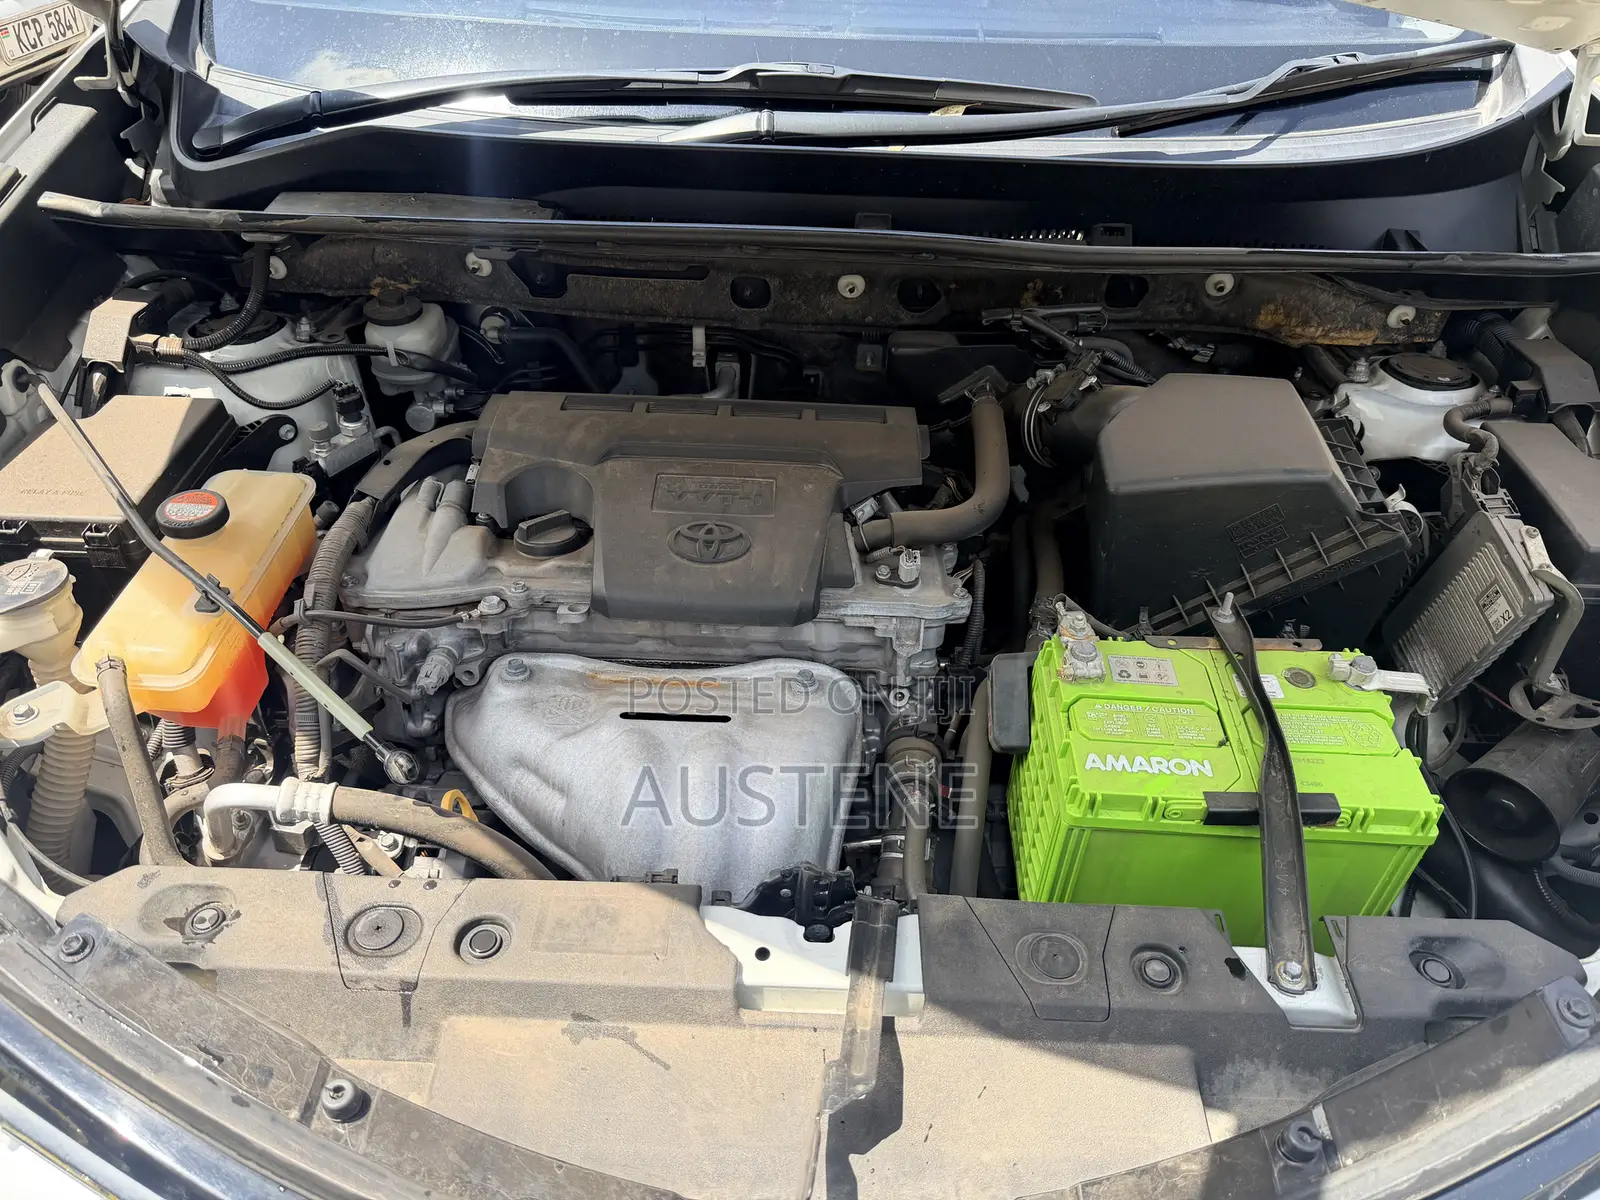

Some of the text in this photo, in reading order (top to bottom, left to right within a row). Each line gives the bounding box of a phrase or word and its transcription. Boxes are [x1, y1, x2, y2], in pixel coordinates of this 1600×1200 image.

[12, 6, 79, 54] KCP 584Y
[1500, 609, 1512, 625] X2
[1151, 705, 1194, 714] CAUTION
[1085, 753, 1213, 777] AMARON
